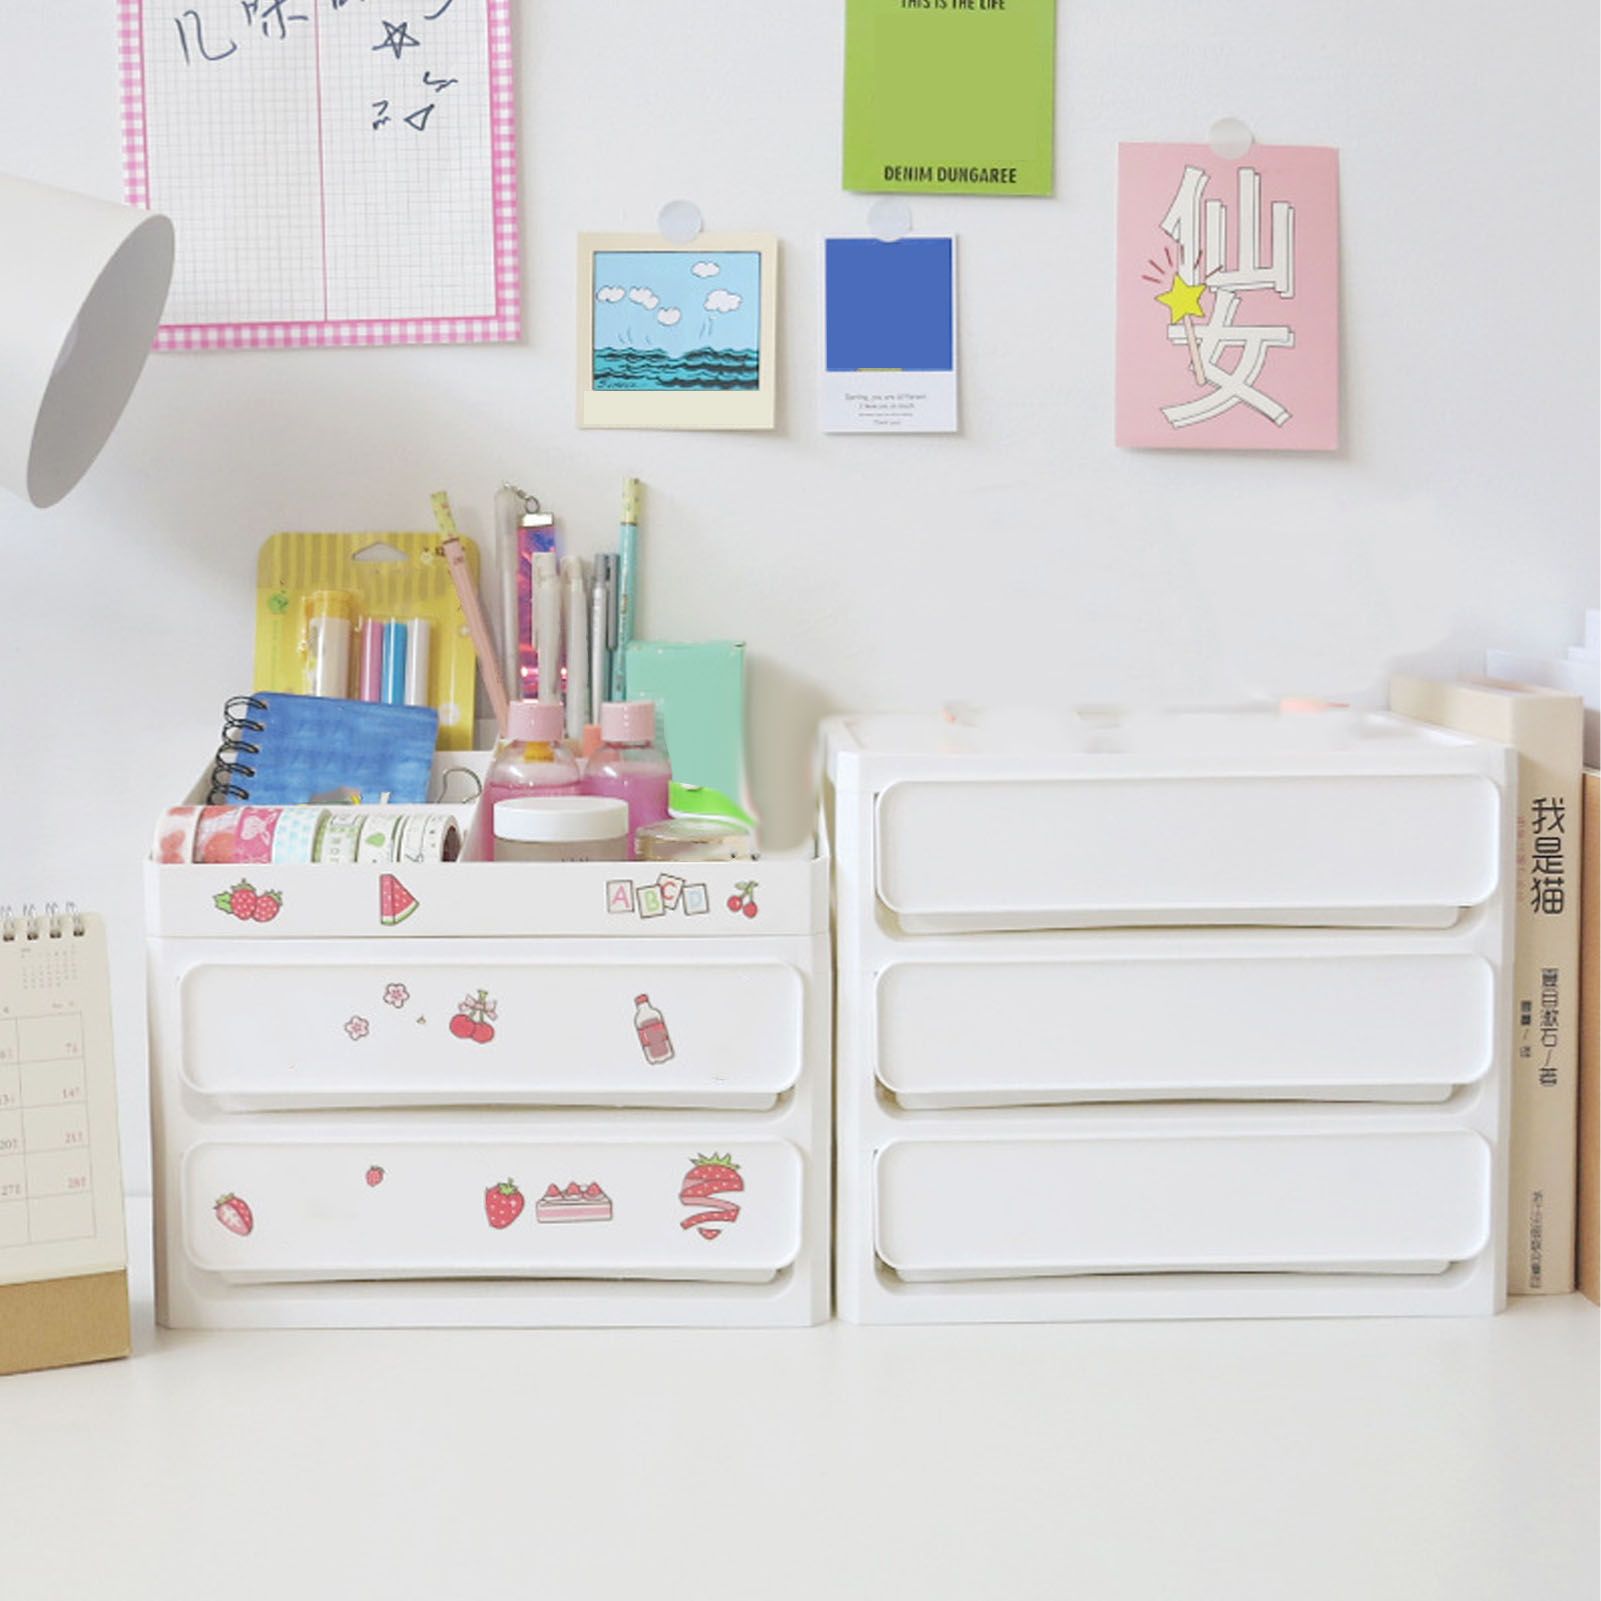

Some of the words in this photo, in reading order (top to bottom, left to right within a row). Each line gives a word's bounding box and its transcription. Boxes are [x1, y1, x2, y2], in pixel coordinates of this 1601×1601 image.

[901, 0, 931, 9] THIS
[934, 0, 948, 9] IS
[951, 0, 975, 9] THE
[979, 0, 1006, 9] LIFE
[884, 165, 933, 182] DENIM
[937, 166, 1017, 184] DUNGAREE
[1159, 164, 1296, 430] 仙女
[1530, 797, 1565, 914] 我是猫
